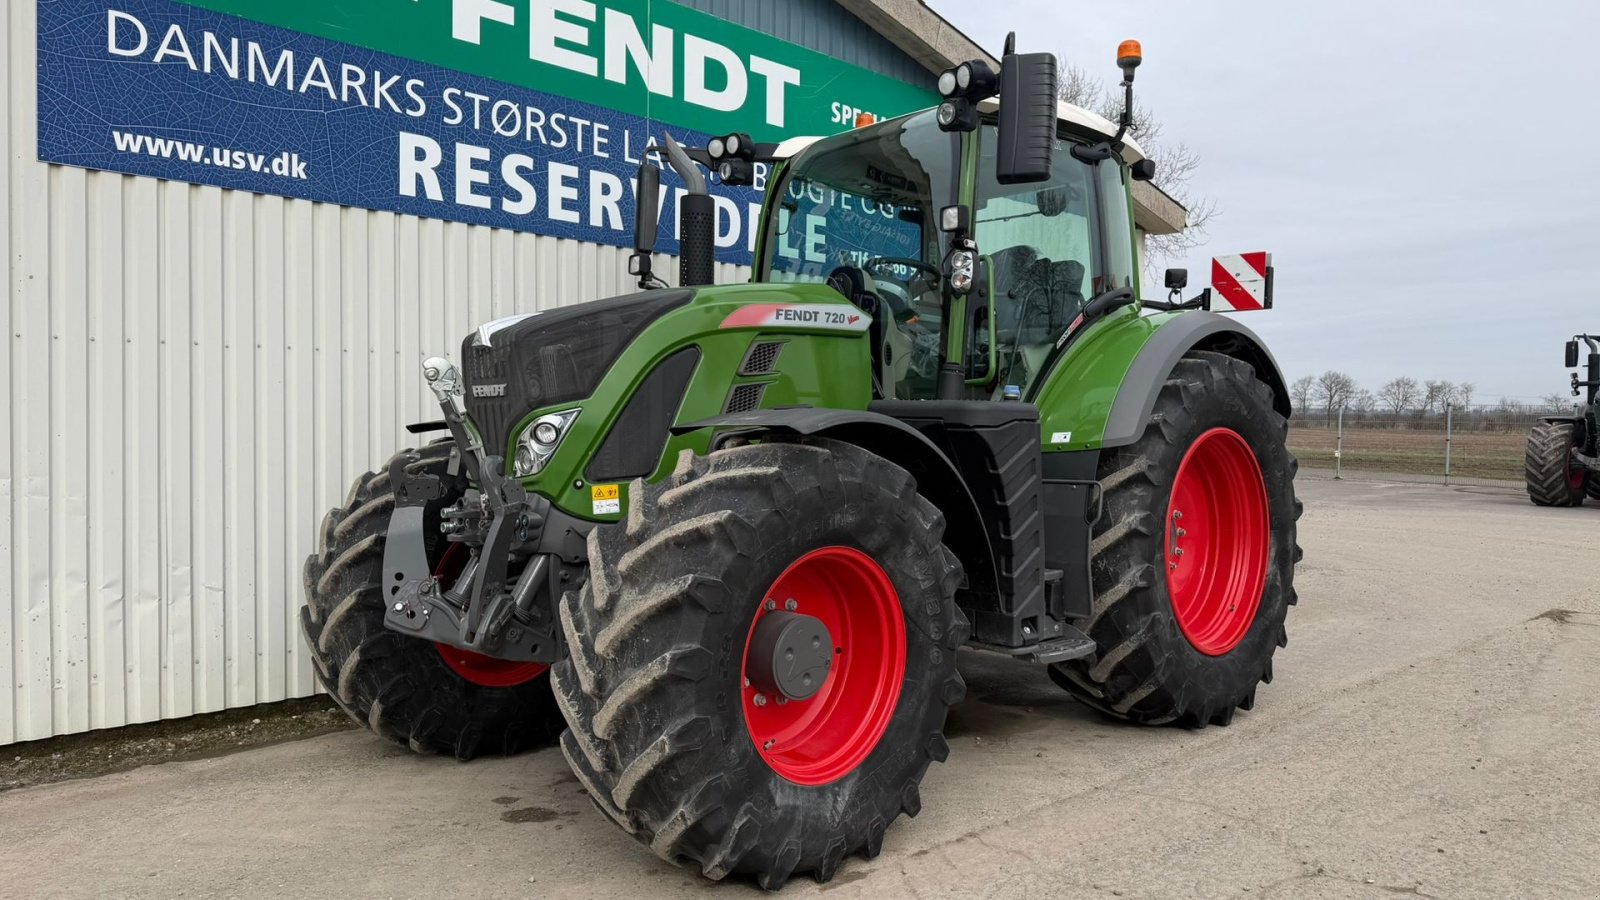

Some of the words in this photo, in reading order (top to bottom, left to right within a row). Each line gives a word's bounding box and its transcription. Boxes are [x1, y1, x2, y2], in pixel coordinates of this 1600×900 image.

[107, 9, 426, 118] DANMARKS
[442, 87, 609, 159] STØRSTE
[452, 0, 801, 129] FENDT
[112, 130, 308, 180] www.usv.dk
[775, 308, 820, 322] FENDT
[824, 311, 845, 324] 720
[471, 383, 507, 398] FENDT
